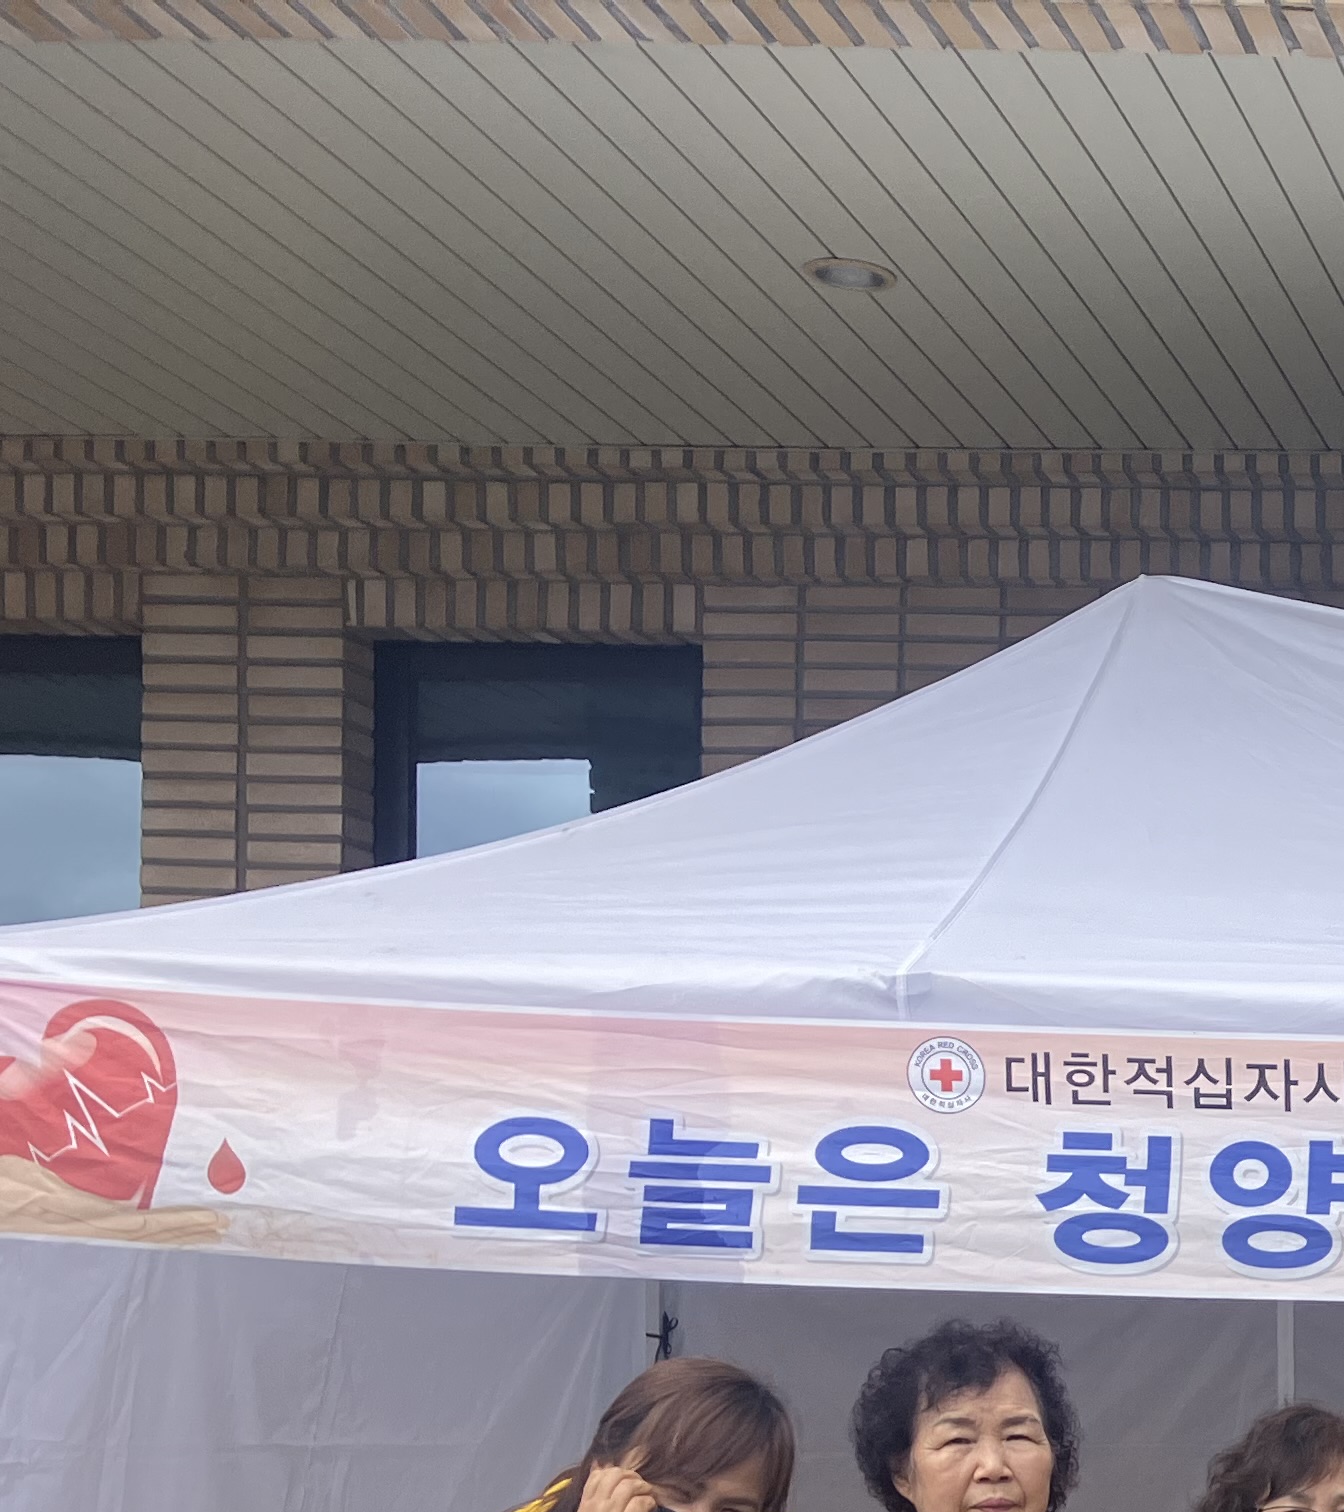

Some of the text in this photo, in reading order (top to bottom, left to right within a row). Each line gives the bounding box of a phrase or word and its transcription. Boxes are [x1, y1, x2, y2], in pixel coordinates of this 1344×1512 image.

[914, 1041, 979, 1070] KOREA RED CROSS
[454, 1116, 941, 1254] 오늘은
